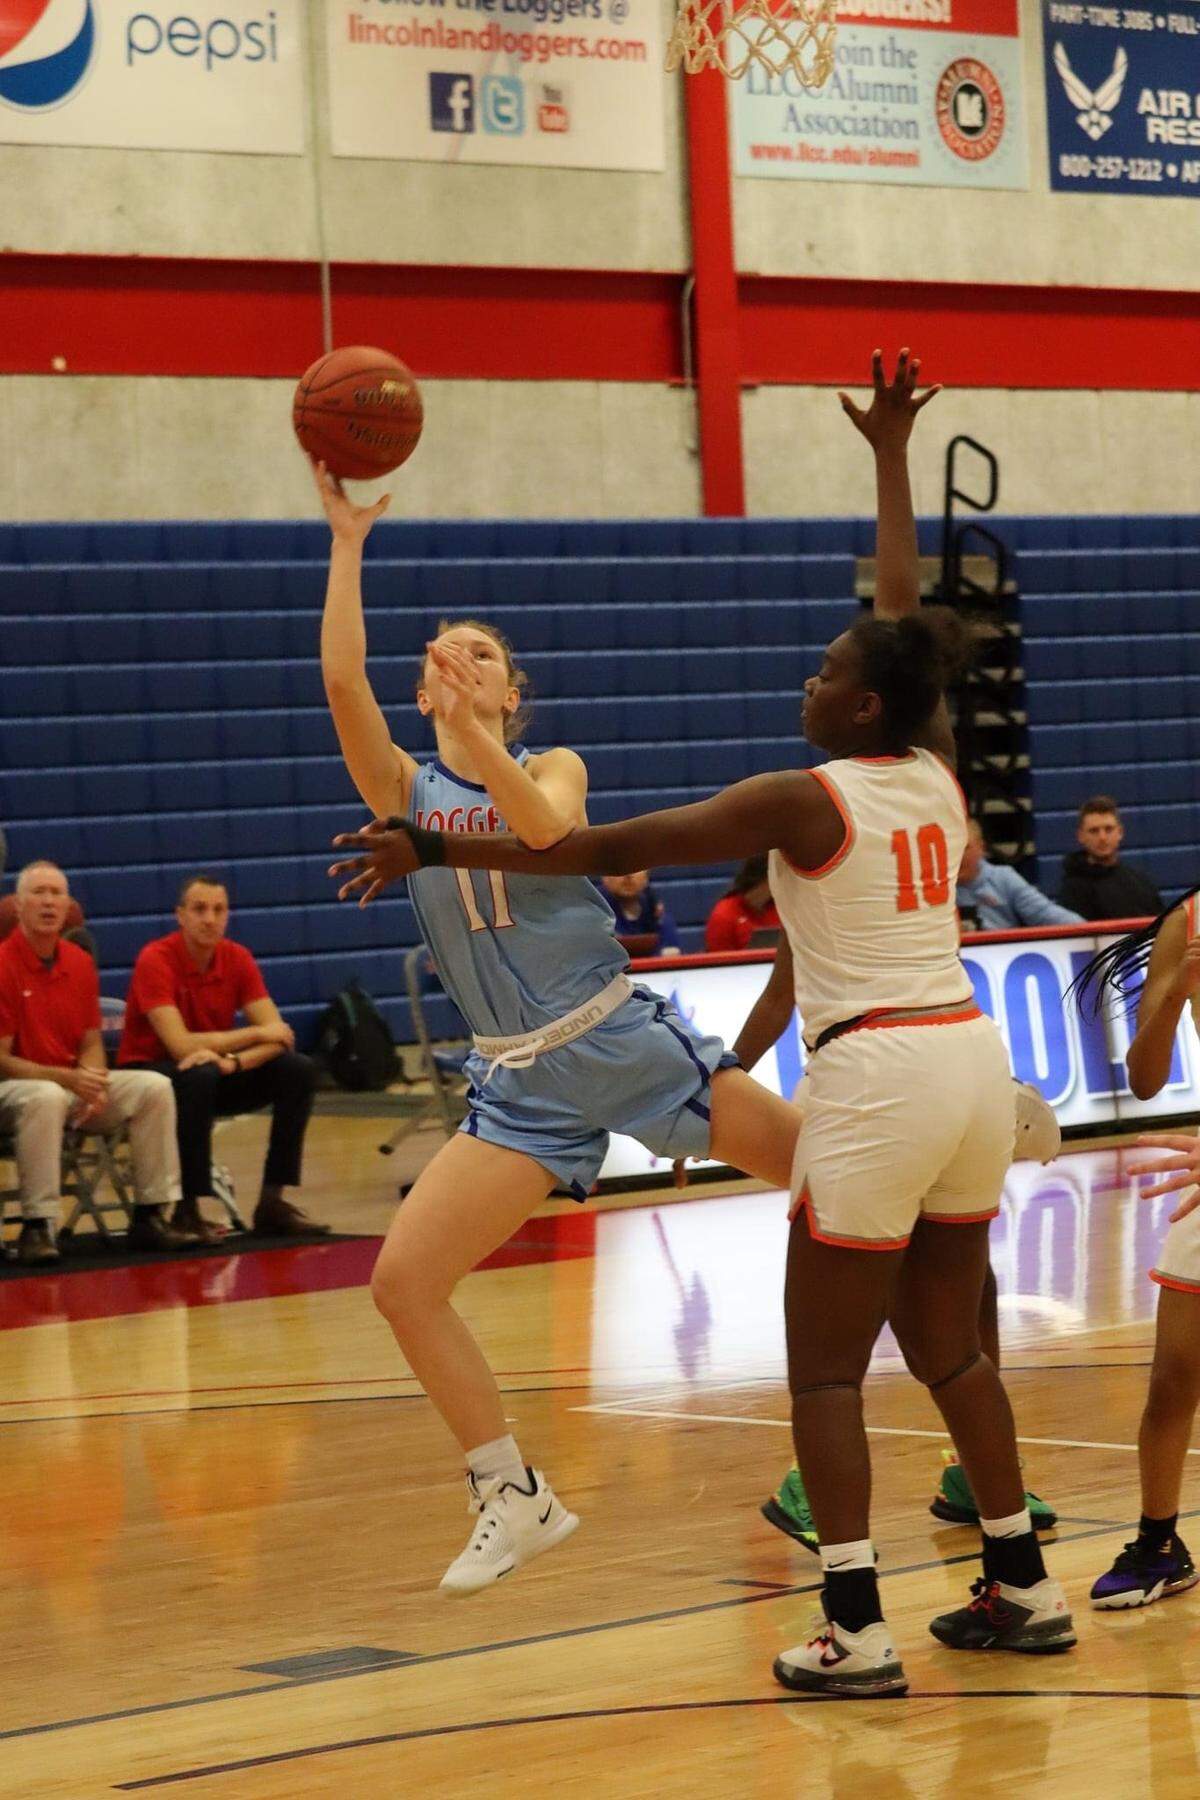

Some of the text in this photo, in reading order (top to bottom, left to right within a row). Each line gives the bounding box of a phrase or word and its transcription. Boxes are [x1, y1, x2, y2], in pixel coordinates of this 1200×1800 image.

[502, 0, 602, 23] Loggers
[607, 0, 630, 25] @
[1049, 3, 1120, 28] PART-TIME
[127, 11, 278, 71] pepsi
[348, 14, 647, 62] lincolnlandloggers.com
[832, 34, 918, 69] oin the
[828, 67, 918, 104] Alumni
[1137, 87, 1192, 118] AIR
[782, 102, 919, 140] Association
[1059, 154, 1163, 182] 800-257-1212
[415, 804, 512, 833] LOGGE
[891, 822, 950, 914] 10
